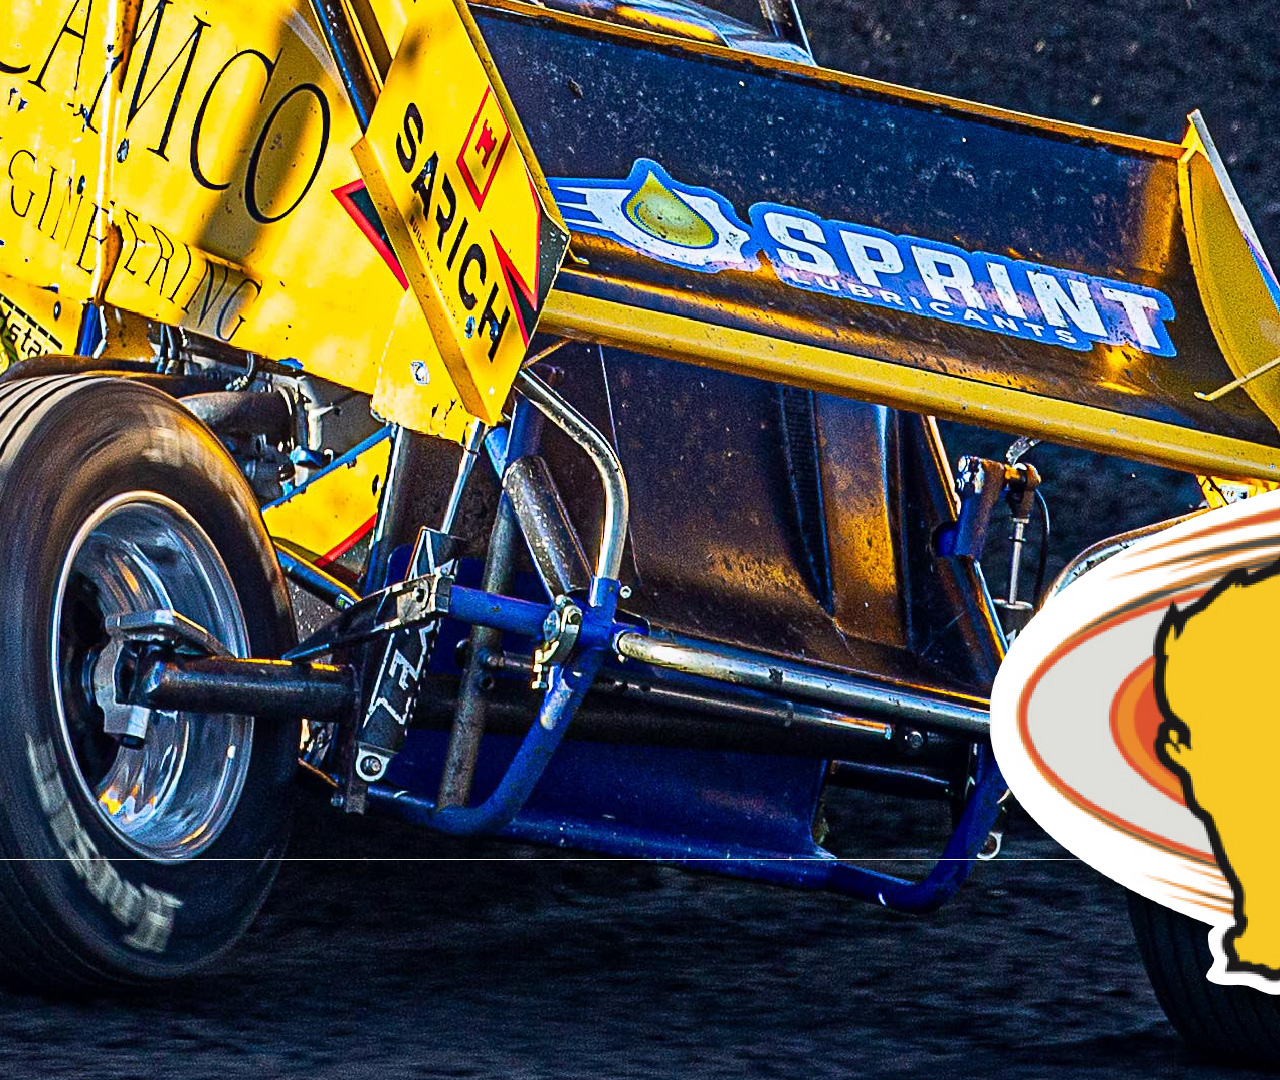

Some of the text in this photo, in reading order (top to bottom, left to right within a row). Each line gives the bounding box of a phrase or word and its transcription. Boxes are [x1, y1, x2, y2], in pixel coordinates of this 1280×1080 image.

[395, 102, 511, 364] SARICH
[763, 210, 1165, 350] SPRINT
[782, 268, 1080, 346] LUBRICANTS
